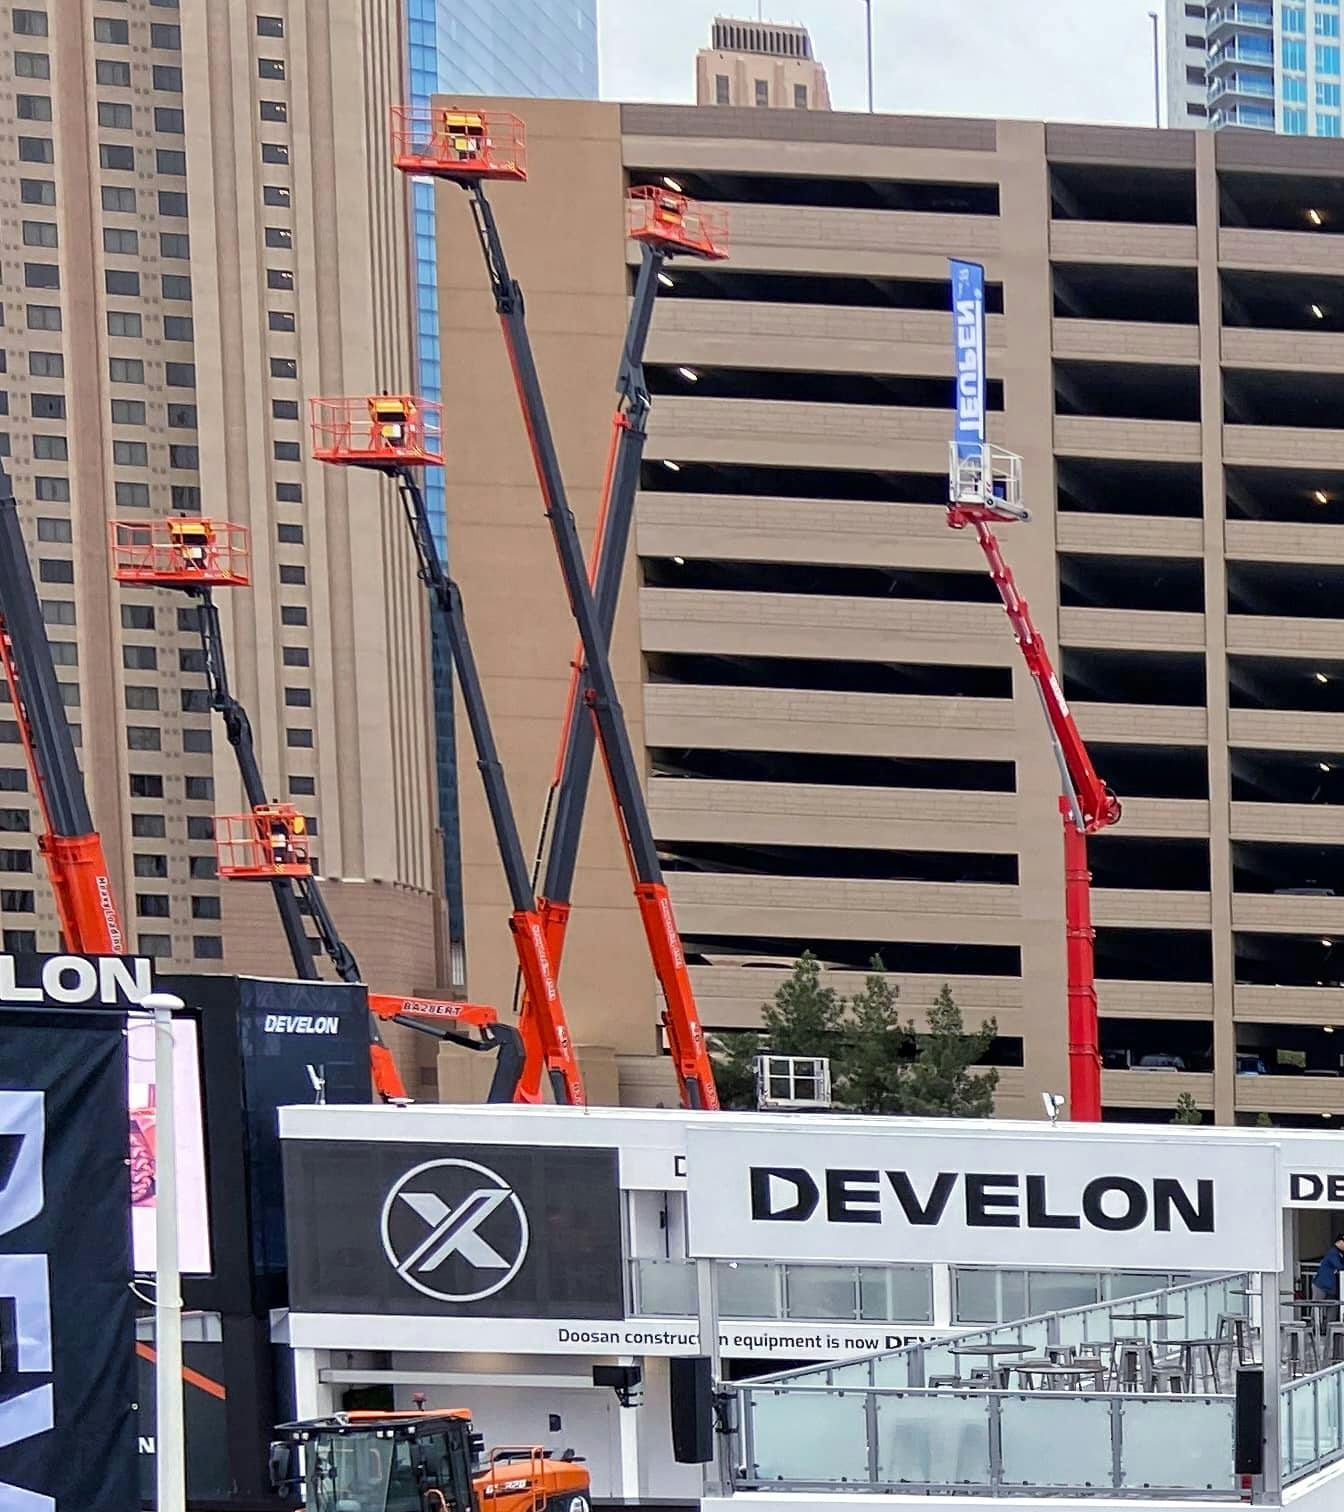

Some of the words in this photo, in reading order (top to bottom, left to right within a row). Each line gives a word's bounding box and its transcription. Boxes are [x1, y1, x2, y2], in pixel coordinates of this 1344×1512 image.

[264, 1015, 339, 1034] DEVELON
[750, 1167, 1214, 1233] DEVELON
[558, 1329, 620, 1344] Doosan
[625, 1331, 728, 1347] constructn
[733, 1334, 822, 1352] equipment
[826, 1335, 840, 1349] is
[844, 1337, 879, 1350] now
